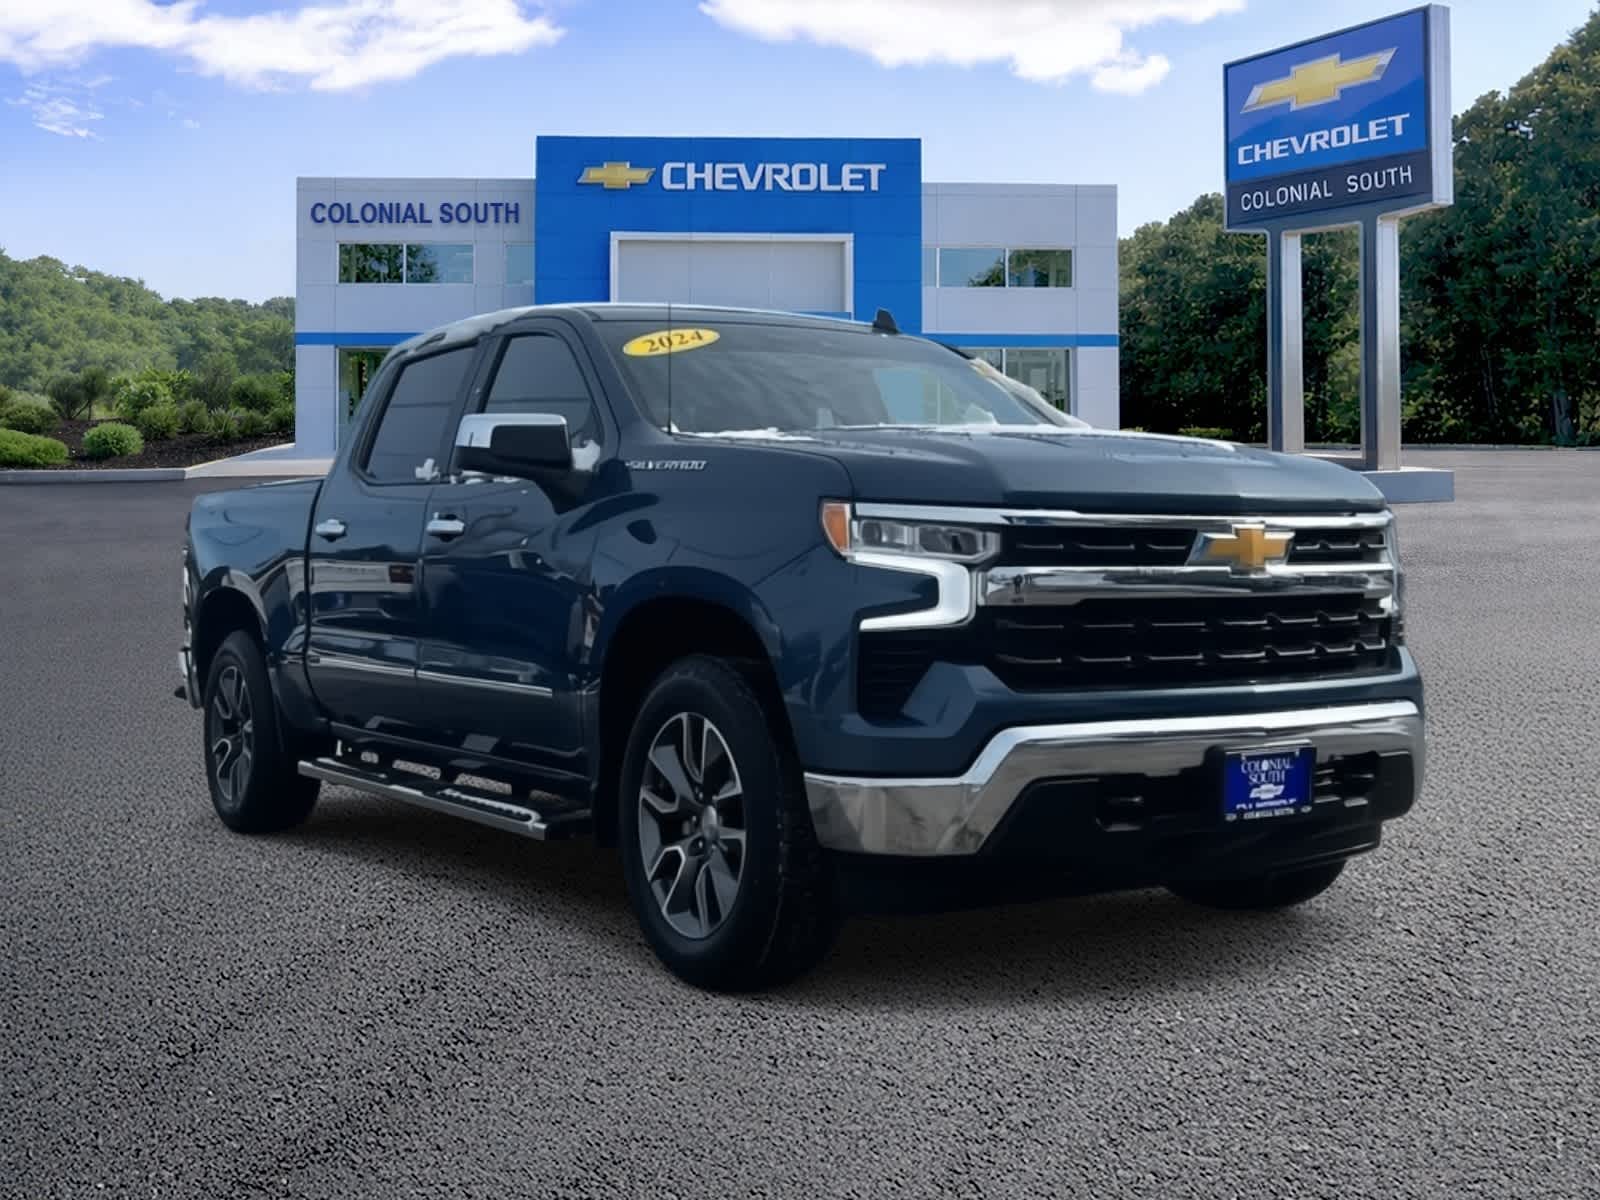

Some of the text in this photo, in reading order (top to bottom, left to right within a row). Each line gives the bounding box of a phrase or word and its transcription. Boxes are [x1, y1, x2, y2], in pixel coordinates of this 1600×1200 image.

[1238, 113, 1410, 165] CHEVROLET
[661, 161, 887, 192] CHEVROLET
[1241, 165, 1412, 211] COLONIAL SOUTH
[310, 201, 520, 225] COLONIAL SOUTH
[644, 331, 703, 352] 2024
